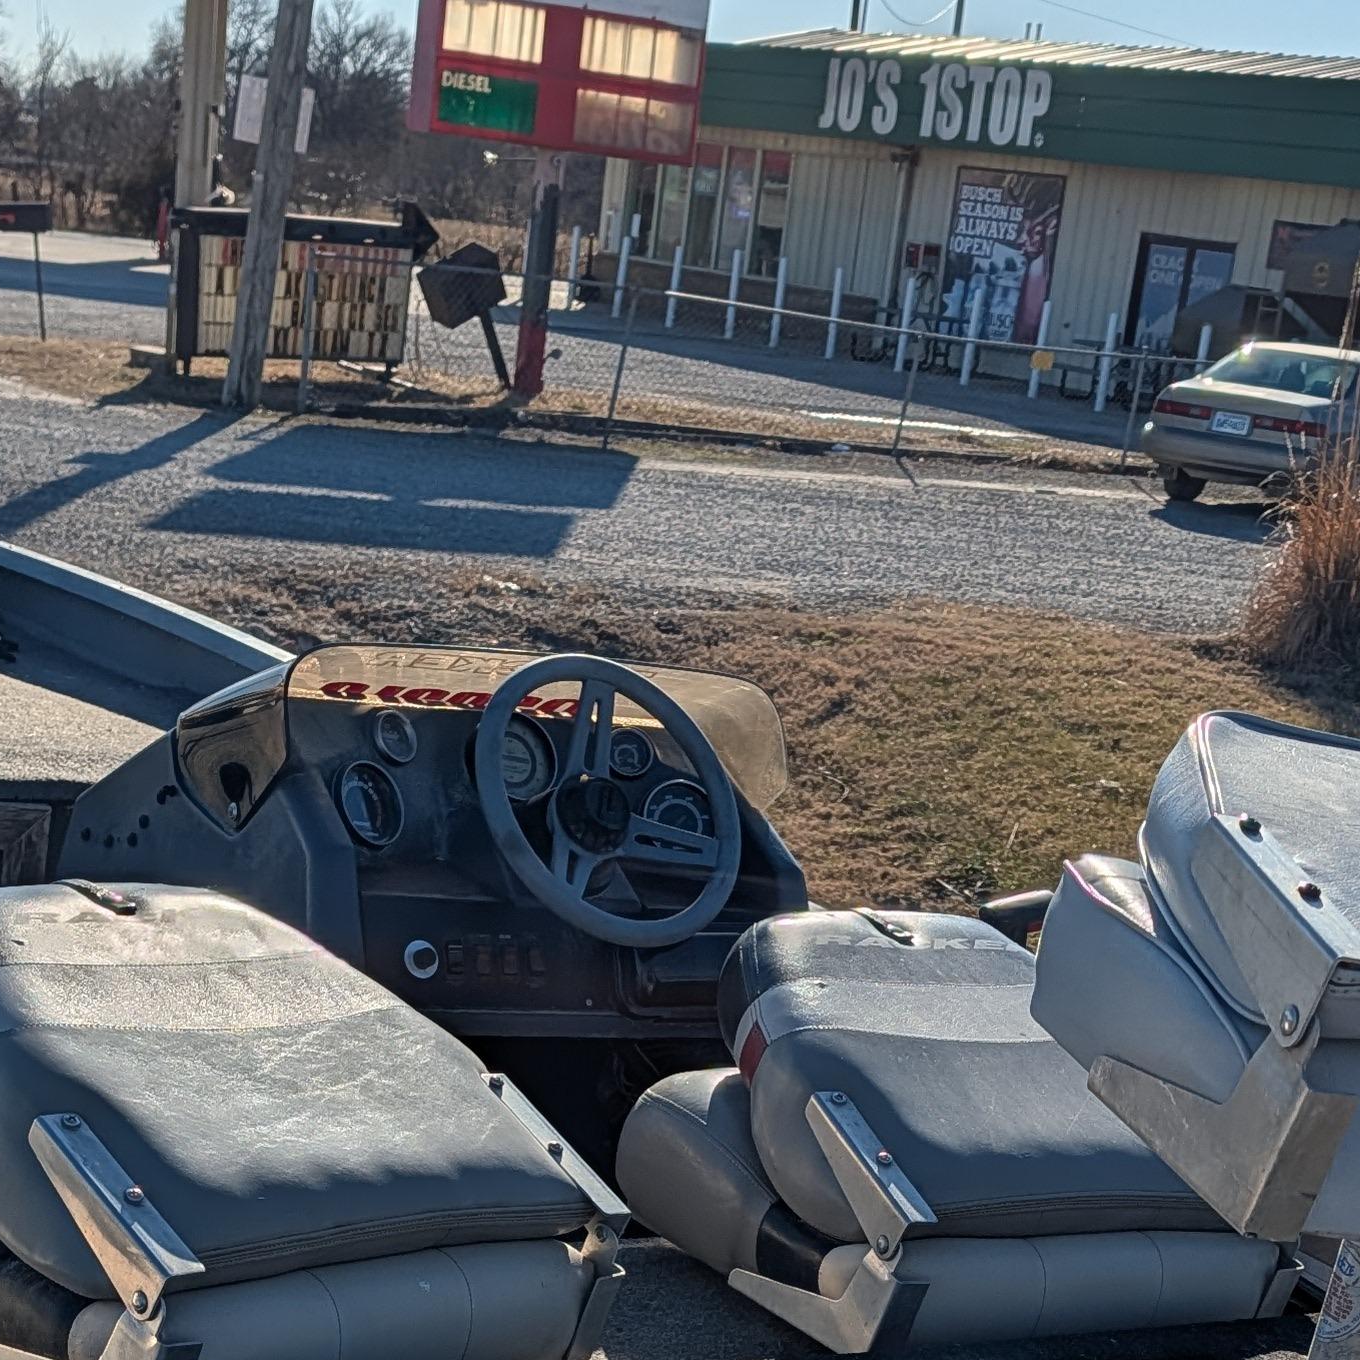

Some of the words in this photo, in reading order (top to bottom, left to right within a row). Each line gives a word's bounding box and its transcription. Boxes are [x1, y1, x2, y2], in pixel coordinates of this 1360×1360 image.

[441, 69, 492, 94] DIESEL
[818, 57, 902, 135] JO'S
[919, 62, 1052, 147] 1STOP
[960, 184, 1003, 203] BUSCH
[958, 200, 1010, 220] SEASON
[1008, 206, 1025, 222] IS
[954, 216, 1019, 240] ALWAYS
[953, 235, 994, 257] OPEN
